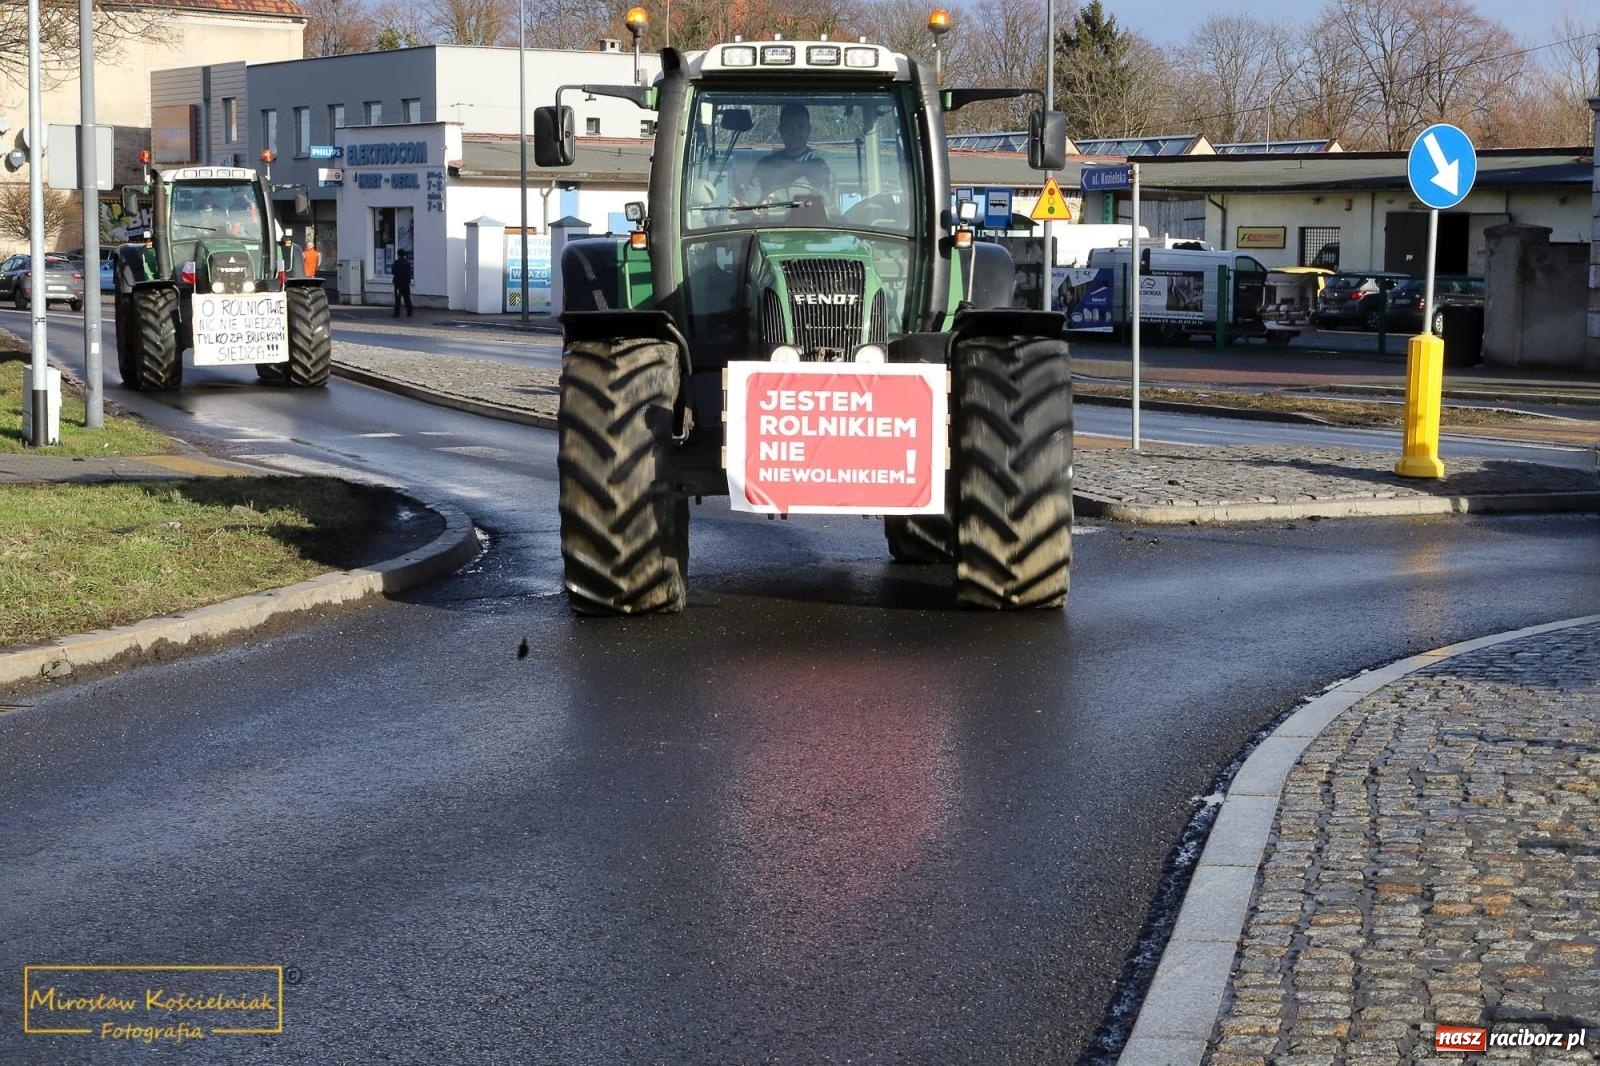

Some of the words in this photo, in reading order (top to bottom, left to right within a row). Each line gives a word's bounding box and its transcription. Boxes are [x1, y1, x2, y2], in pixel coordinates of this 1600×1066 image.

[311, 148, 341, 156] PHILIPS
[347, 141, 428, 166] ELEKTROCOM
[358, 173, 383, 189] HURT
[794, 294, 859, 305] FENDT
[202, 300, 214, 317] O
[199, 319, 215, 331] NIC
[220, 318, 237, 330] NIE
[197, 332, 228, 345] TYLKO
[229, 332, 243, 343] ZA
[759, 389, 873, 412] JESTEM
[759, 415, 917, 438] ROLNIKIEM
[759, 441, 806, 461] NIE
